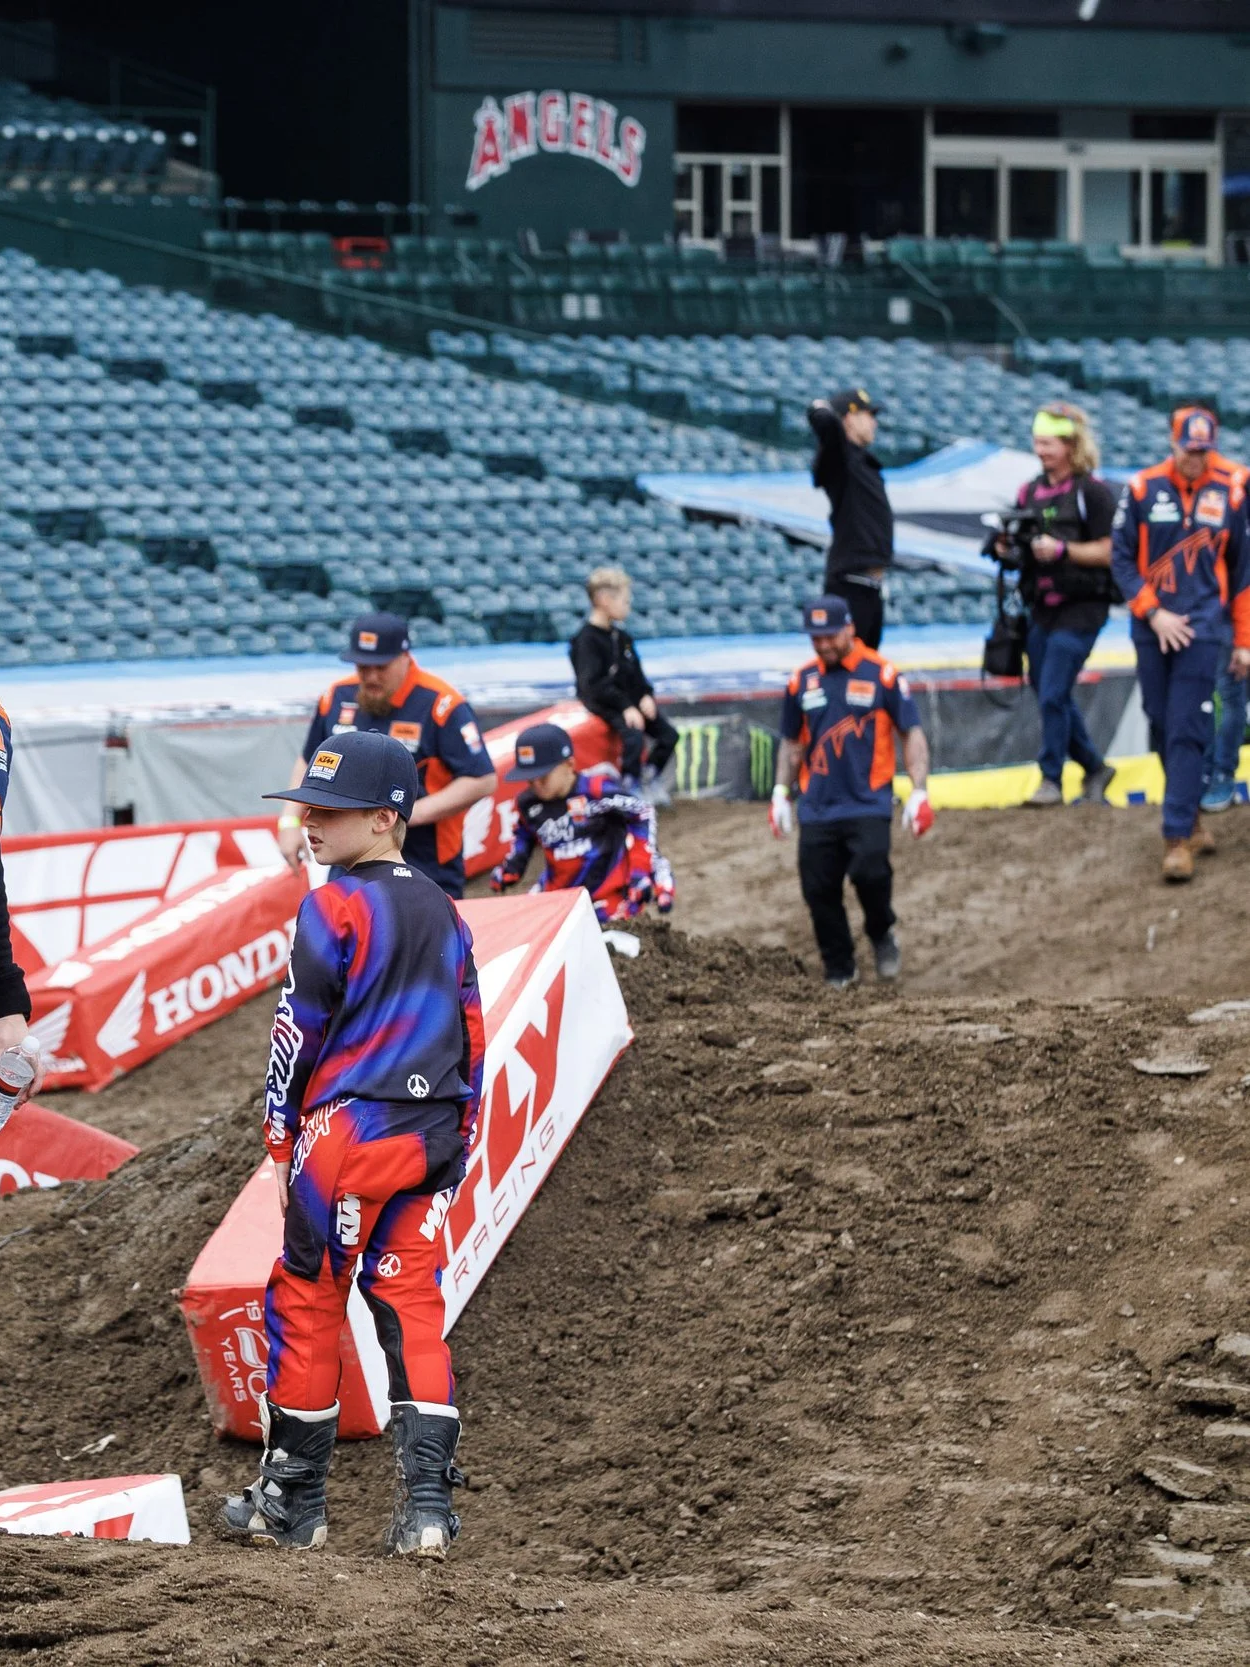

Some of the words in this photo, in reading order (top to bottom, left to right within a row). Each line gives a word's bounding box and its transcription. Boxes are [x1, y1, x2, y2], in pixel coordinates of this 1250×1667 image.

[465, 89, 646, 191] ANGELS
[318, 755, 335, 765] KTM
[393, 866, 413, 878] KTM
[336, 1192, 362, 1246] KTM
[453, 1113, 555, 1282] RACING
[220, 1336, 248, 1403] YEARS
